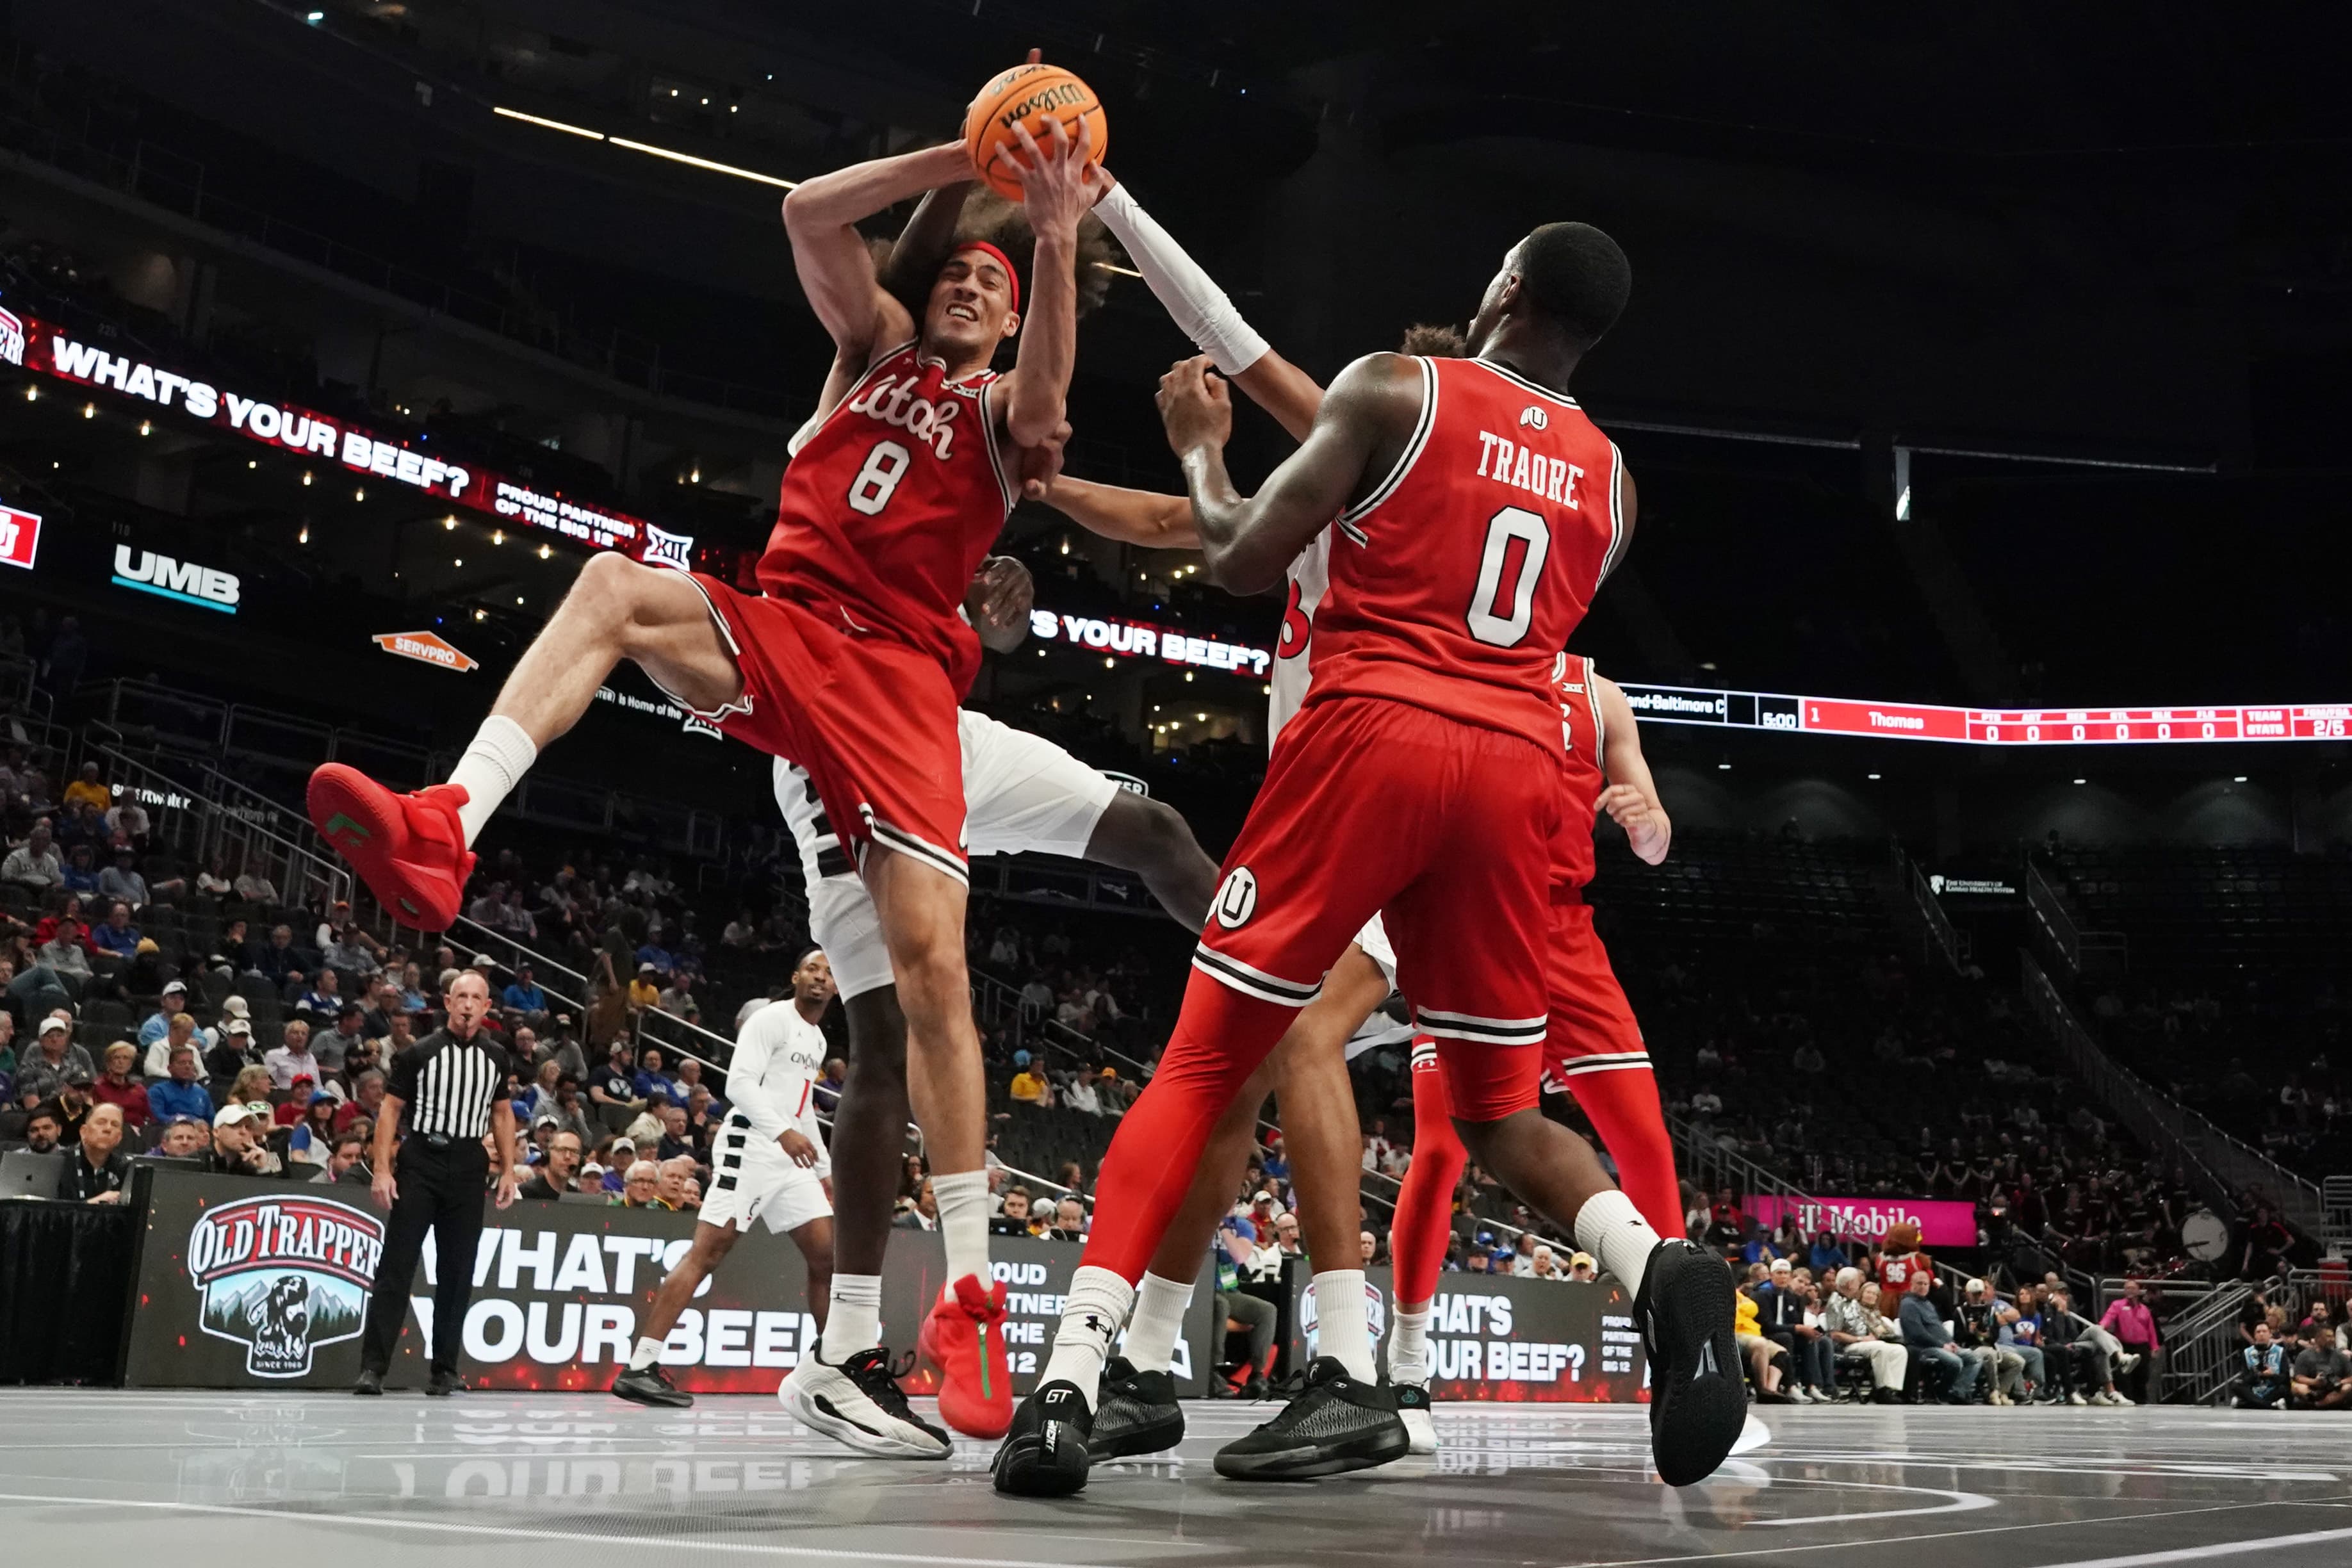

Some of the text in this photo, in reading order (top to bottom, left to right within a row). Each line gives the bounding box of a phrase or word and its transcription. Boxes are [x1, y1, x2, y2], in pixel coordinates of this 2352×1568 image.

[53, 336, 218, 419] WHAT'S
[224, 391, 338, 458] YOUR
[341, 430, 470, 498] BEEF?
[847, 440, 911, 516] 8
[1476, 430, 1585, 511] TRAORE
[494, 498, 521, 516] OF
[523, 506, 557, 530] THE
[497, 482, 636, 539] PROUD PARTNER
[113, 543, 241, 605] UMB
[1466, 505, 1551, 648] 0
[395, 637, 457, 664] SERVPRO
[1063, 614, 1157, 657] YOUR
[1160, 632, 1271, 676] BEEF?
[1623, 692, 1714, 714] and-Baltimore
[1762, 712, 1797, 728] 5:00
[1811, 707, 1924, 730] 1 Thomas
[2247, 710, 2283, 722] TEAM
[1986, 723, 2216, 741] 0 0 0 0 0 0
[2313, 719, 2346, 737] 2/5
[193, 1218, 254, 1274] OLD
[411, 1296, 636, 1365] OUR
[1425, 1293, 1513, 1336] HAT'S
[1006, 1352, 1037, 1374] 12
[1425, 1337, 1585, 1382] OUR BEEF?
